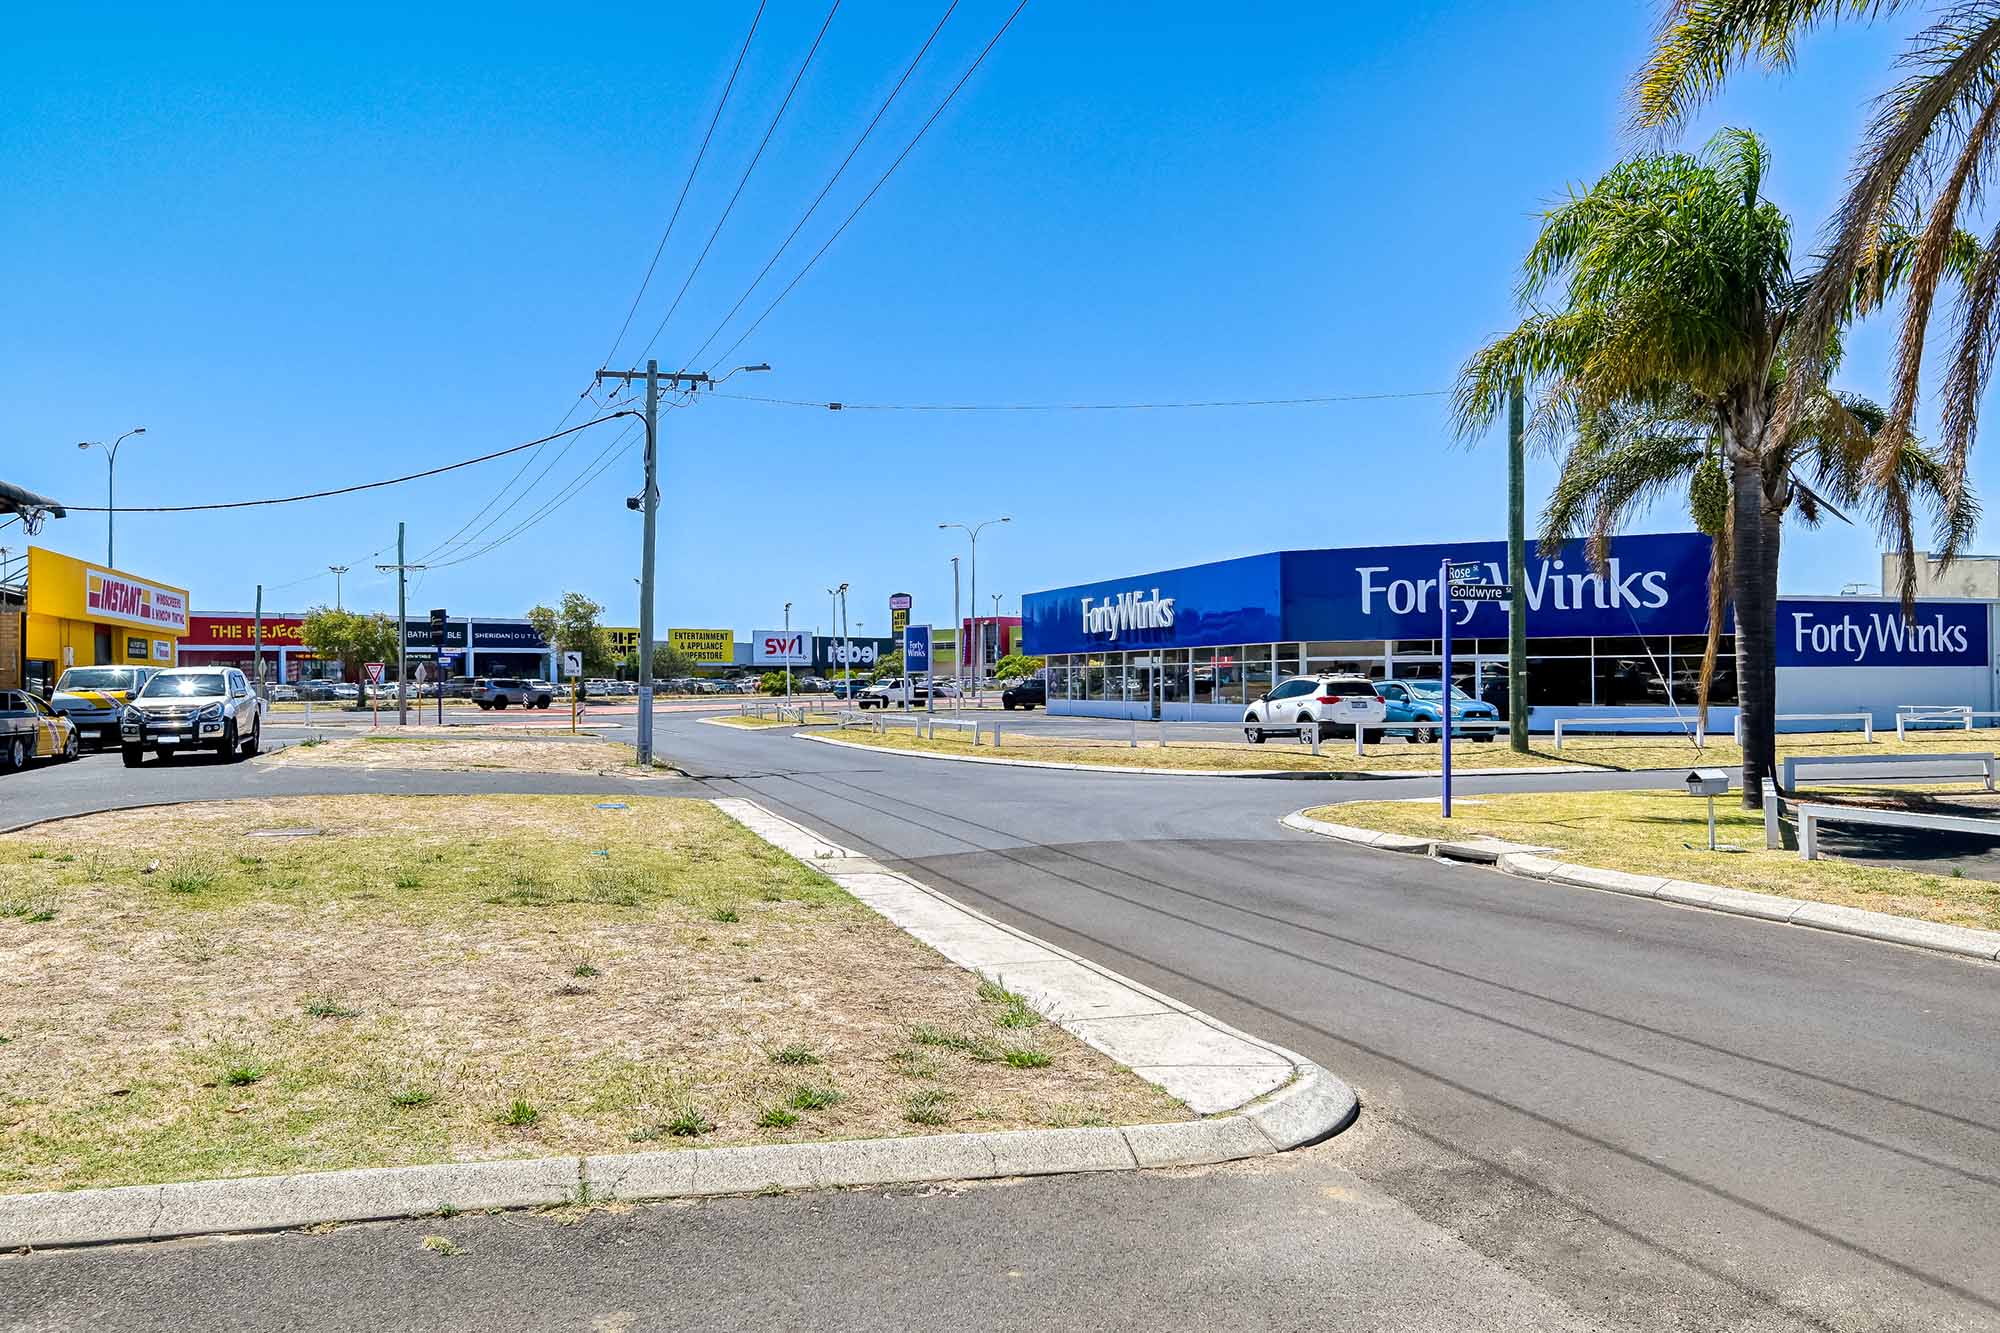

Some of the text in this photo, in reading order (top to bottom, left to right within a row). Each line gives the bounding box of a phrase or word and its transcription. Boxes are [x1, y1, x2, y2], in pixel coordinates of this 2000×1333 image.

[1449, 566, 1471, 579] Rose
[101, 579, 142, 616] INSTANT
[1451, 586, 1503, 600] Goldwyre
[210, 623, 303, 639] THE REJEC
[407, 631, 428, 639] BATH
[474, 632, 538, 640] SHERIDAN OUTL
[674, 632, 728, 641] ENTERTAINMENT
[680, 642, 723, 650] & APPLIANCE
[765, 634, 802, 655] SW1
[909, 640, 924, 649] Forty
[681, 651, 723, 660] PERSTORE
[828, 641, 878, 663] rebel
[908, 649, 926, 657] Winks
